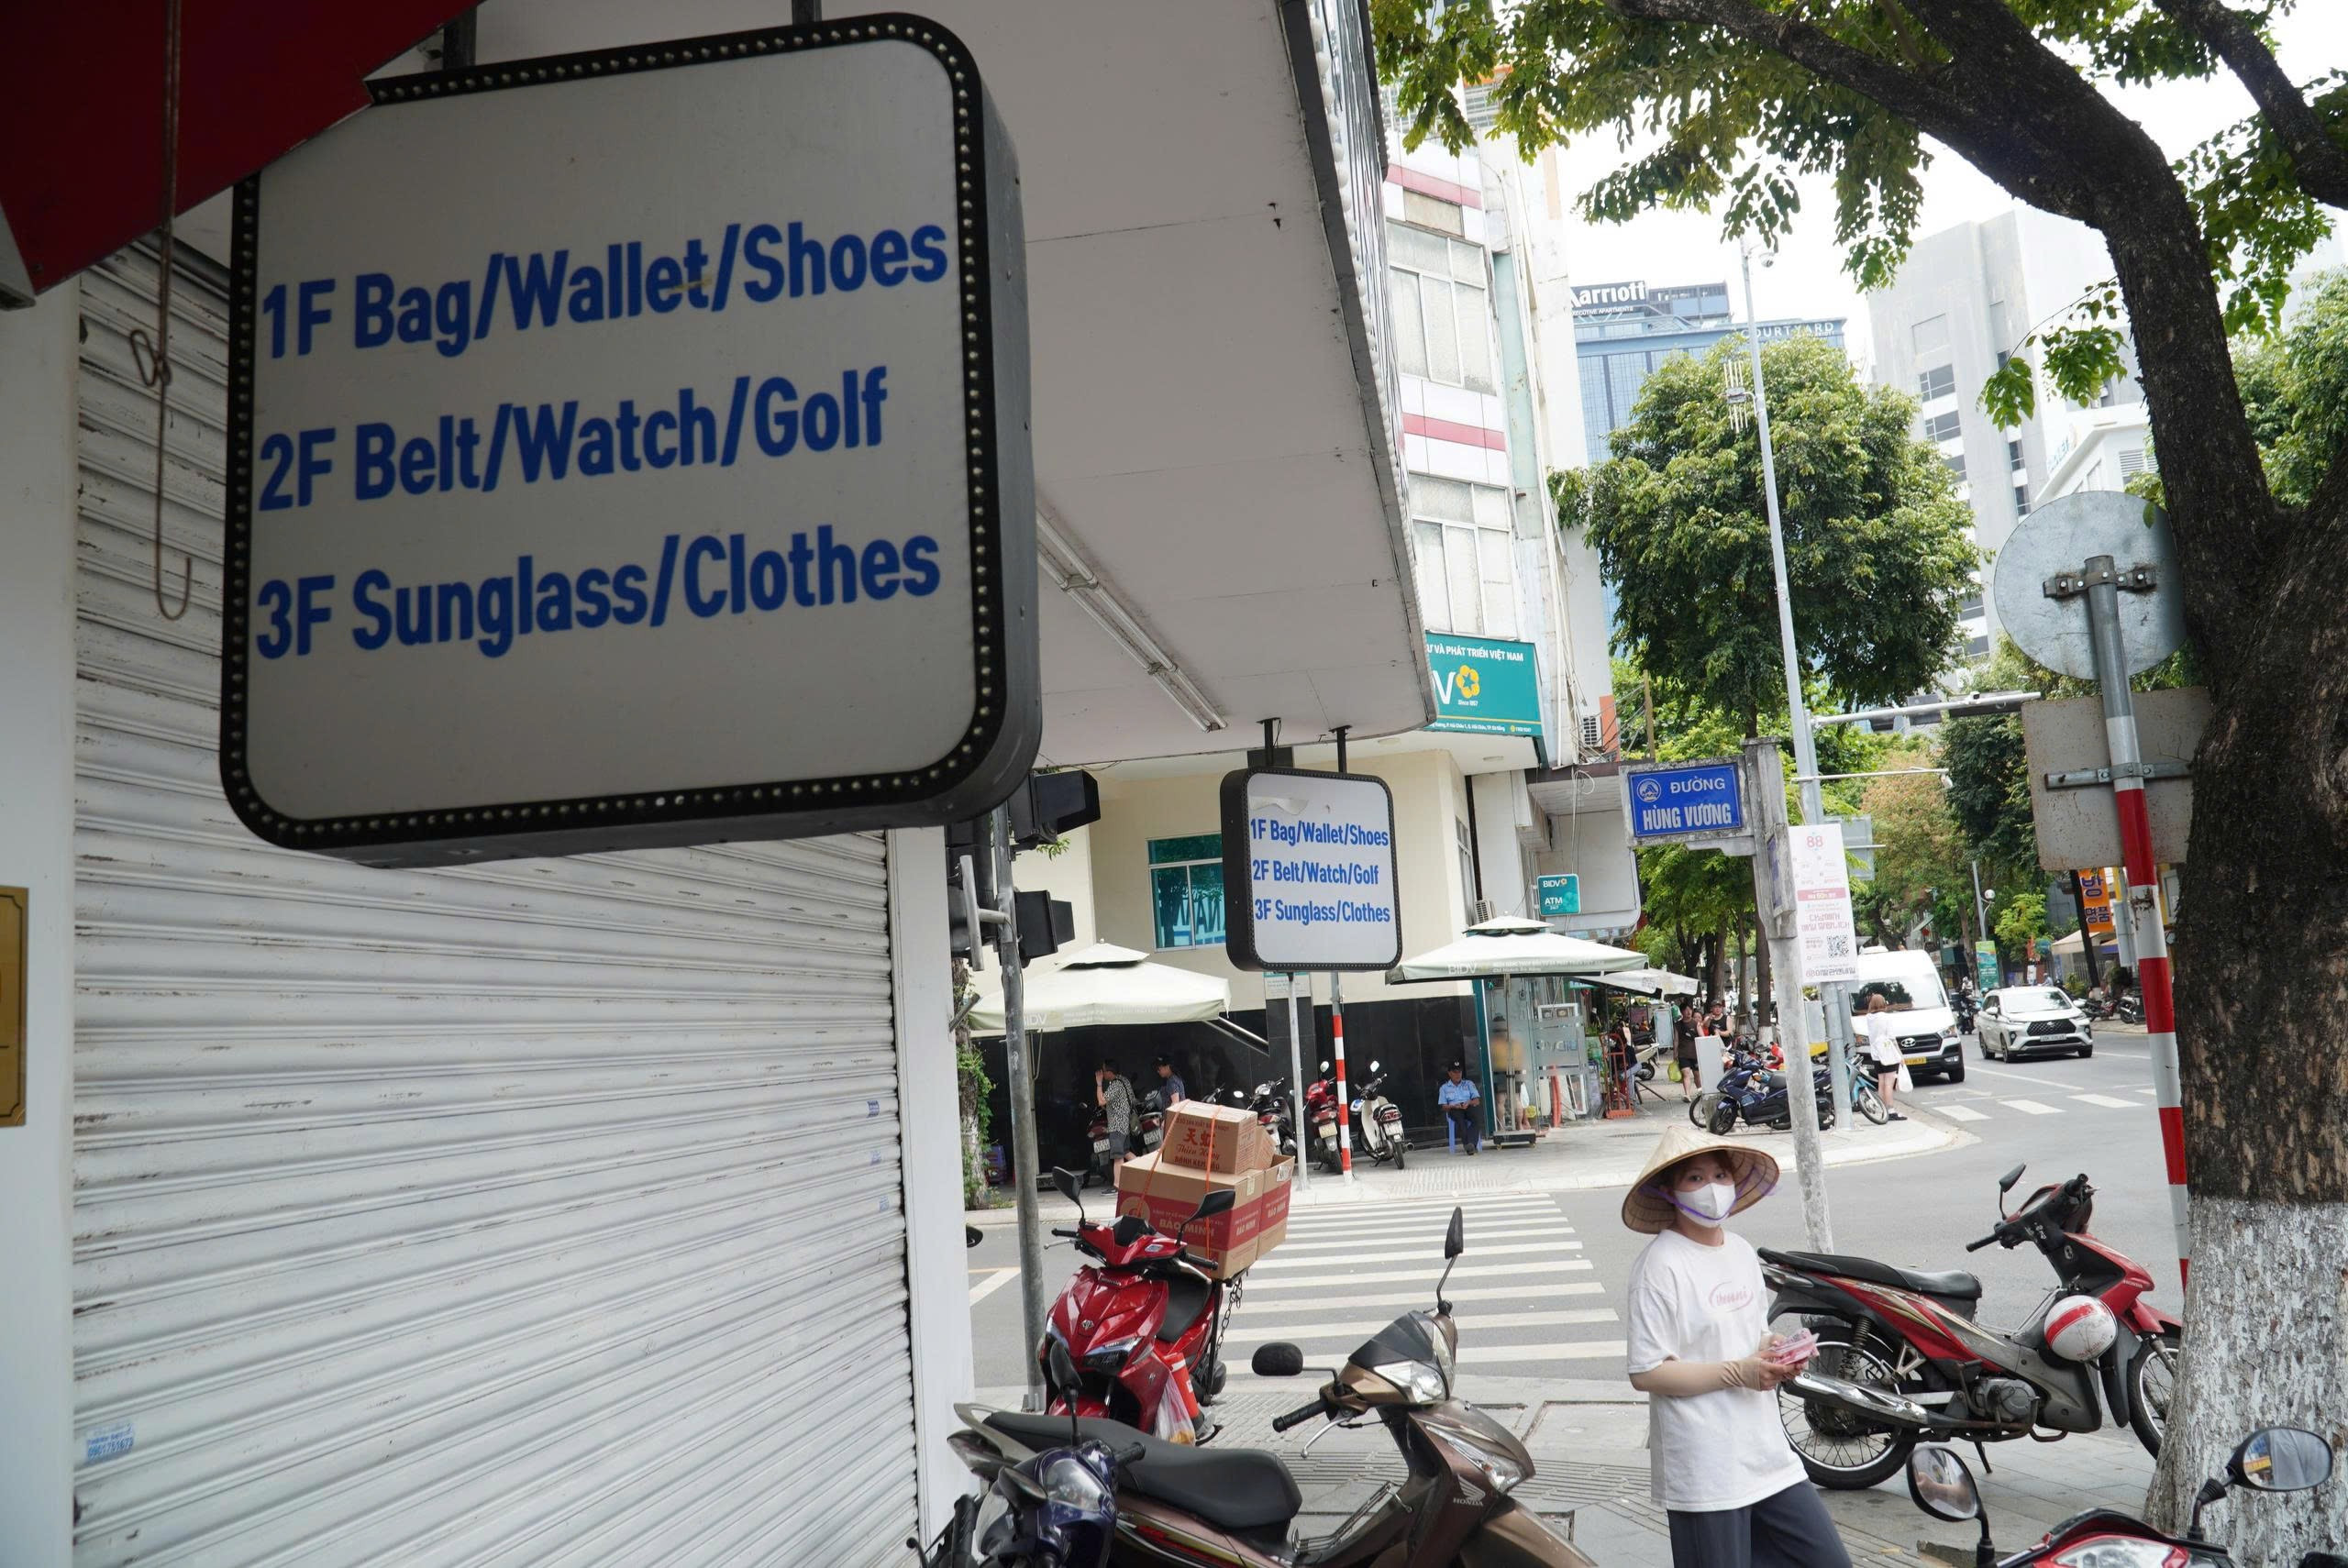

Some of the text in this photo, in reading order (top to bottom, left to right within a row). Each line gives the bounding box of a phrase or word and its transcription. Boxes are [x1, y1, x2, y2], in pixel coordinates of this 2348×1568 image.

[260, 223, 947, 359] 1F Bag/Wallet/Shoes
[1572, 308, 1597, 316] XECUTIVE
[259, 366, 889, 511] 2F Belt/Watch/Golf
[257, 525, 940, 660] 3F Sunglass/Clothes
[1434, 644, 1445, 655] VÀ
[1445, 645, 1466, 656] PHÁT
[1490, 648, 1506, 660] VIỆT
[1507, 653, 1523, 661] NAM
[1670, 776, 1725, 793] ĐƯỜNG
[1643, 803, 1732, 830] HÙNG VƯƠNG
[1250, 819, 1389, 846] 1F Bag/Wallet/Shoes
[1807, 835, 1822, 847] 88
[1253, 859, 1379, 885] 2F Belt/Watch/Golf
[1545, 897, 1563, 905] ATM
[1255, 899, 1390, 925] 3F Sunglass/Clothes
[2085, 906, 2110, 924] 명품
[1449, 962, 1477, 974] BIDV
[1159, 1217, 1181, 1231] BẢO
[1453, 1497, 1483, 1507] HONDA
